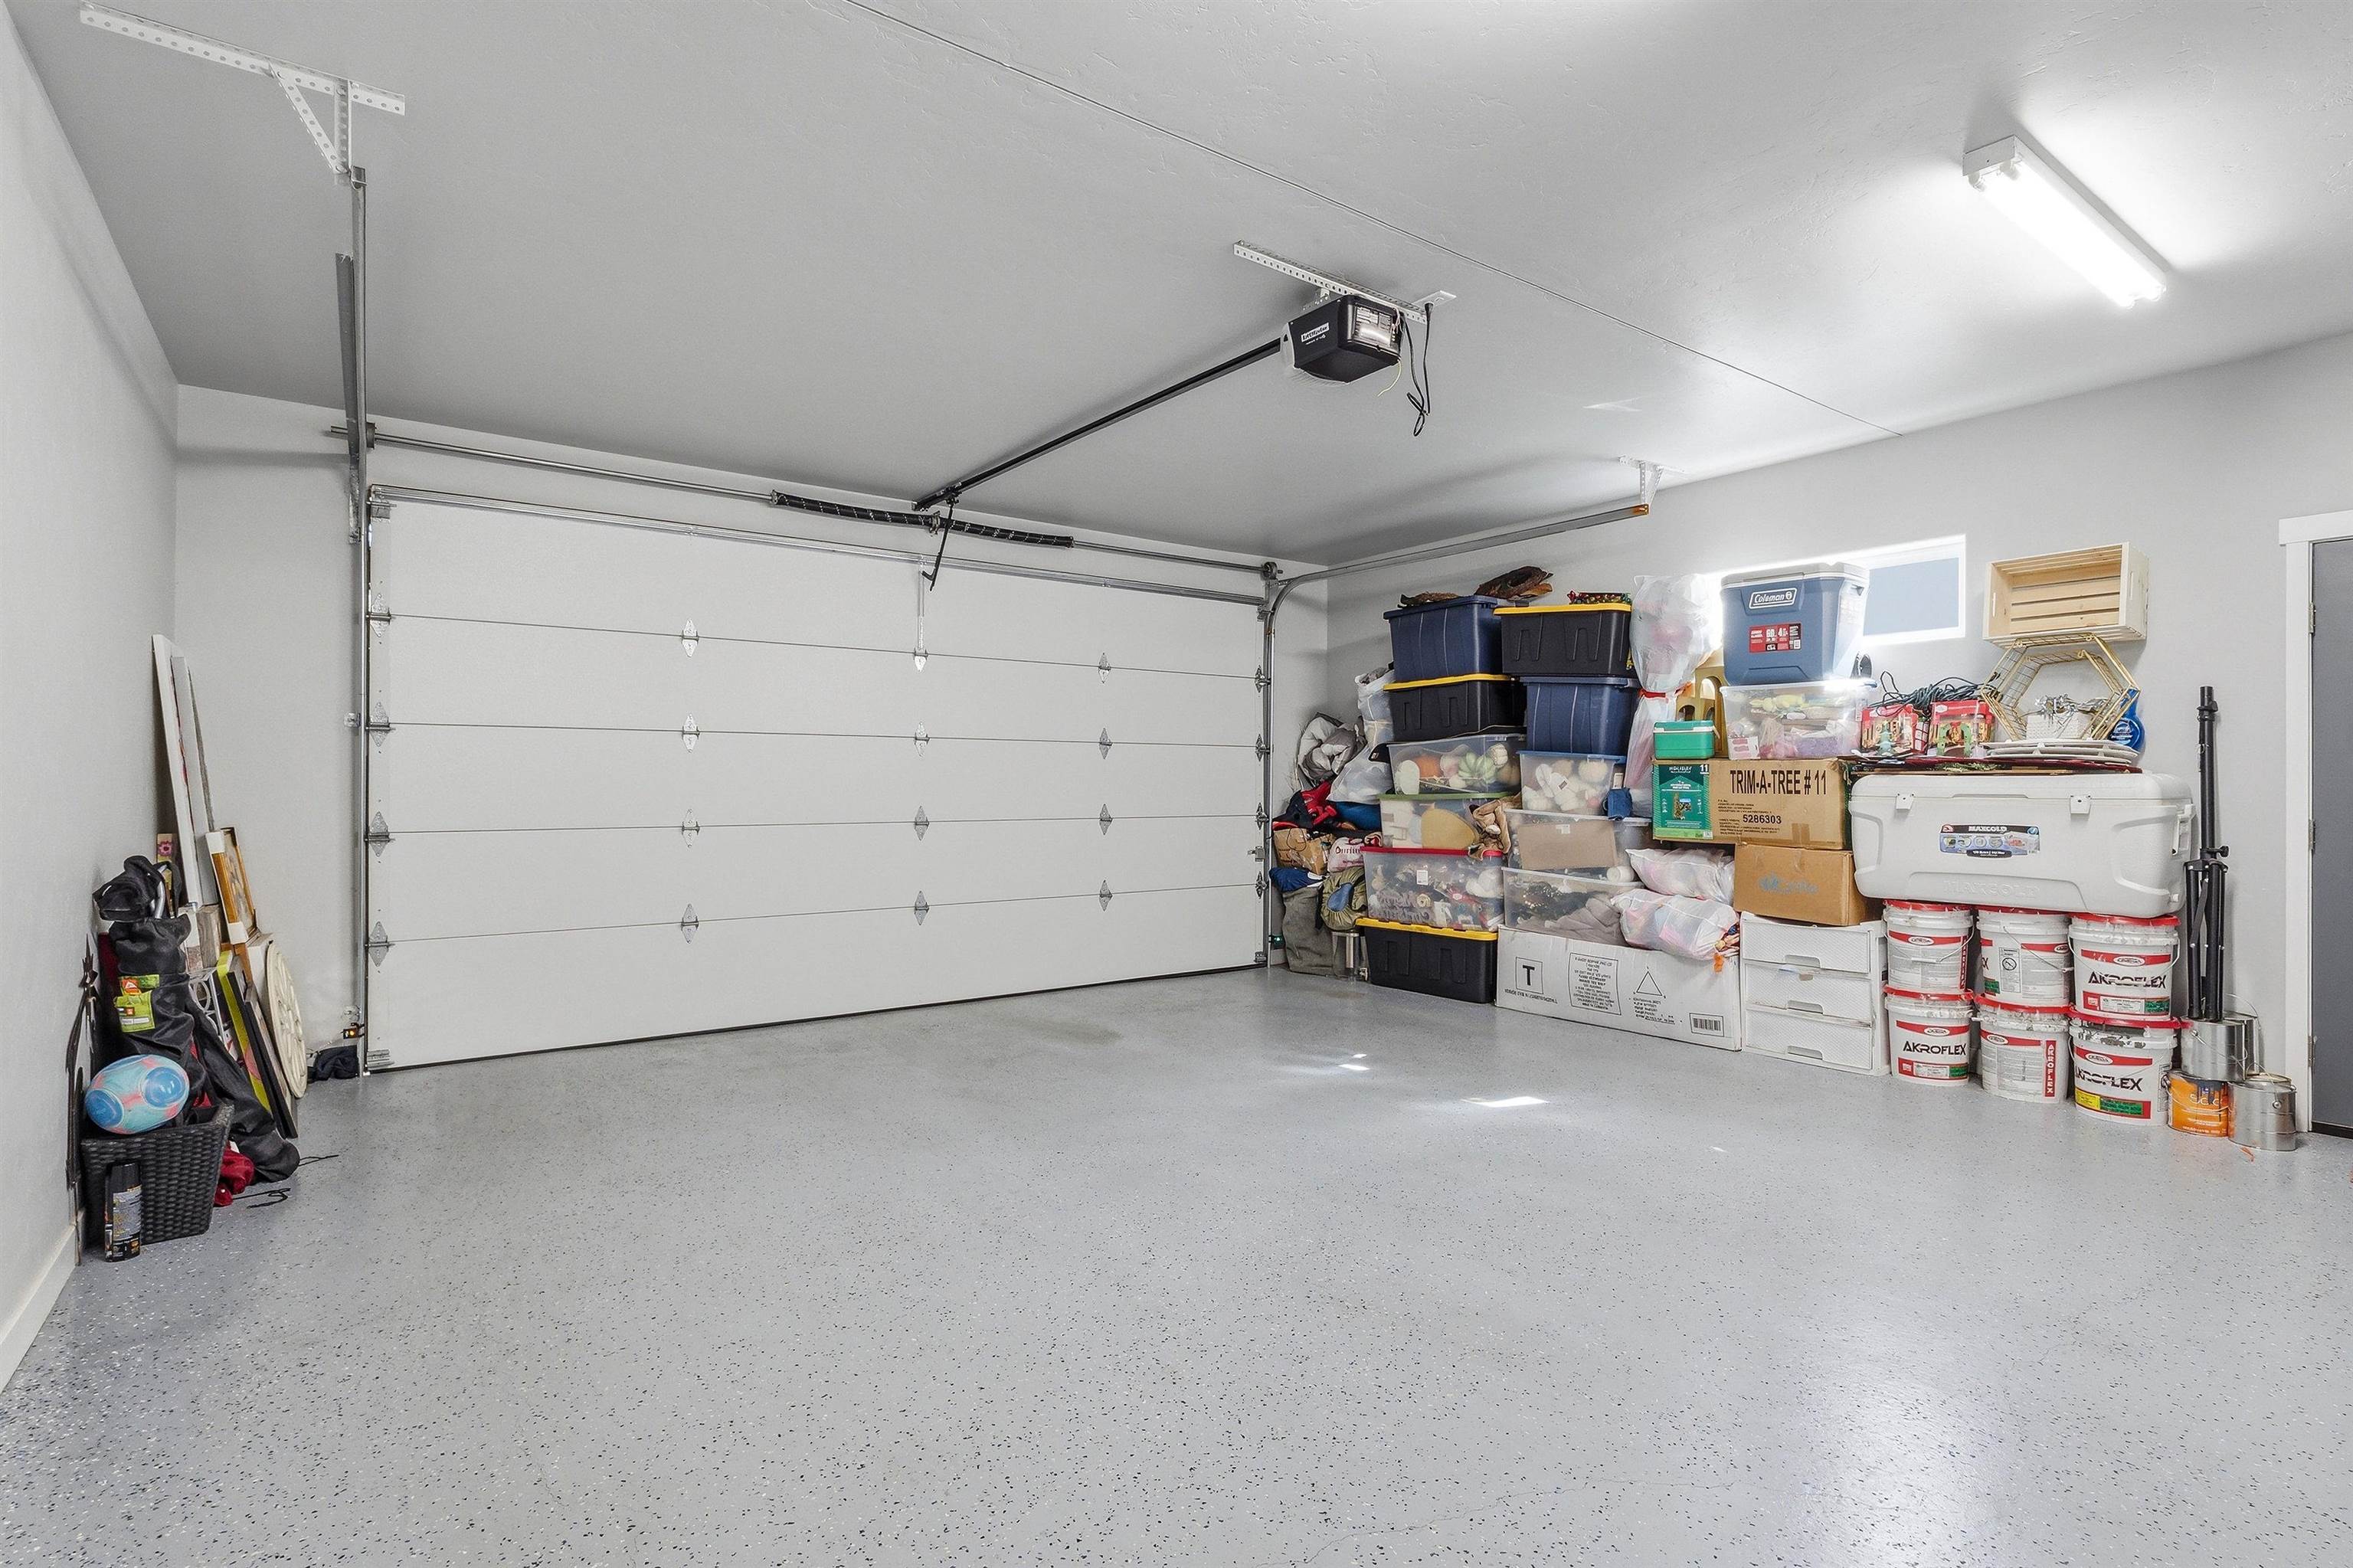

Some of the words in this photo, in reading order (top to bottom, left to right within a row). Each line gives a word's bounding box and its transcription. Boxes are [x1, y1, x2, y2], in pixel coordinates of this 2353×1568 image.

[1754, 594, 1785, 604] Coleman
[1730, 770, 1801, 794] TRIM-A-TREE
[1743, 814, 1782, 824] 5286303
[1522, 964, 1535, 986] T
[2088, 971, 2167, 989] AKROFLEX
[1903, 1040, 1967, 1056] AKROFLEX
